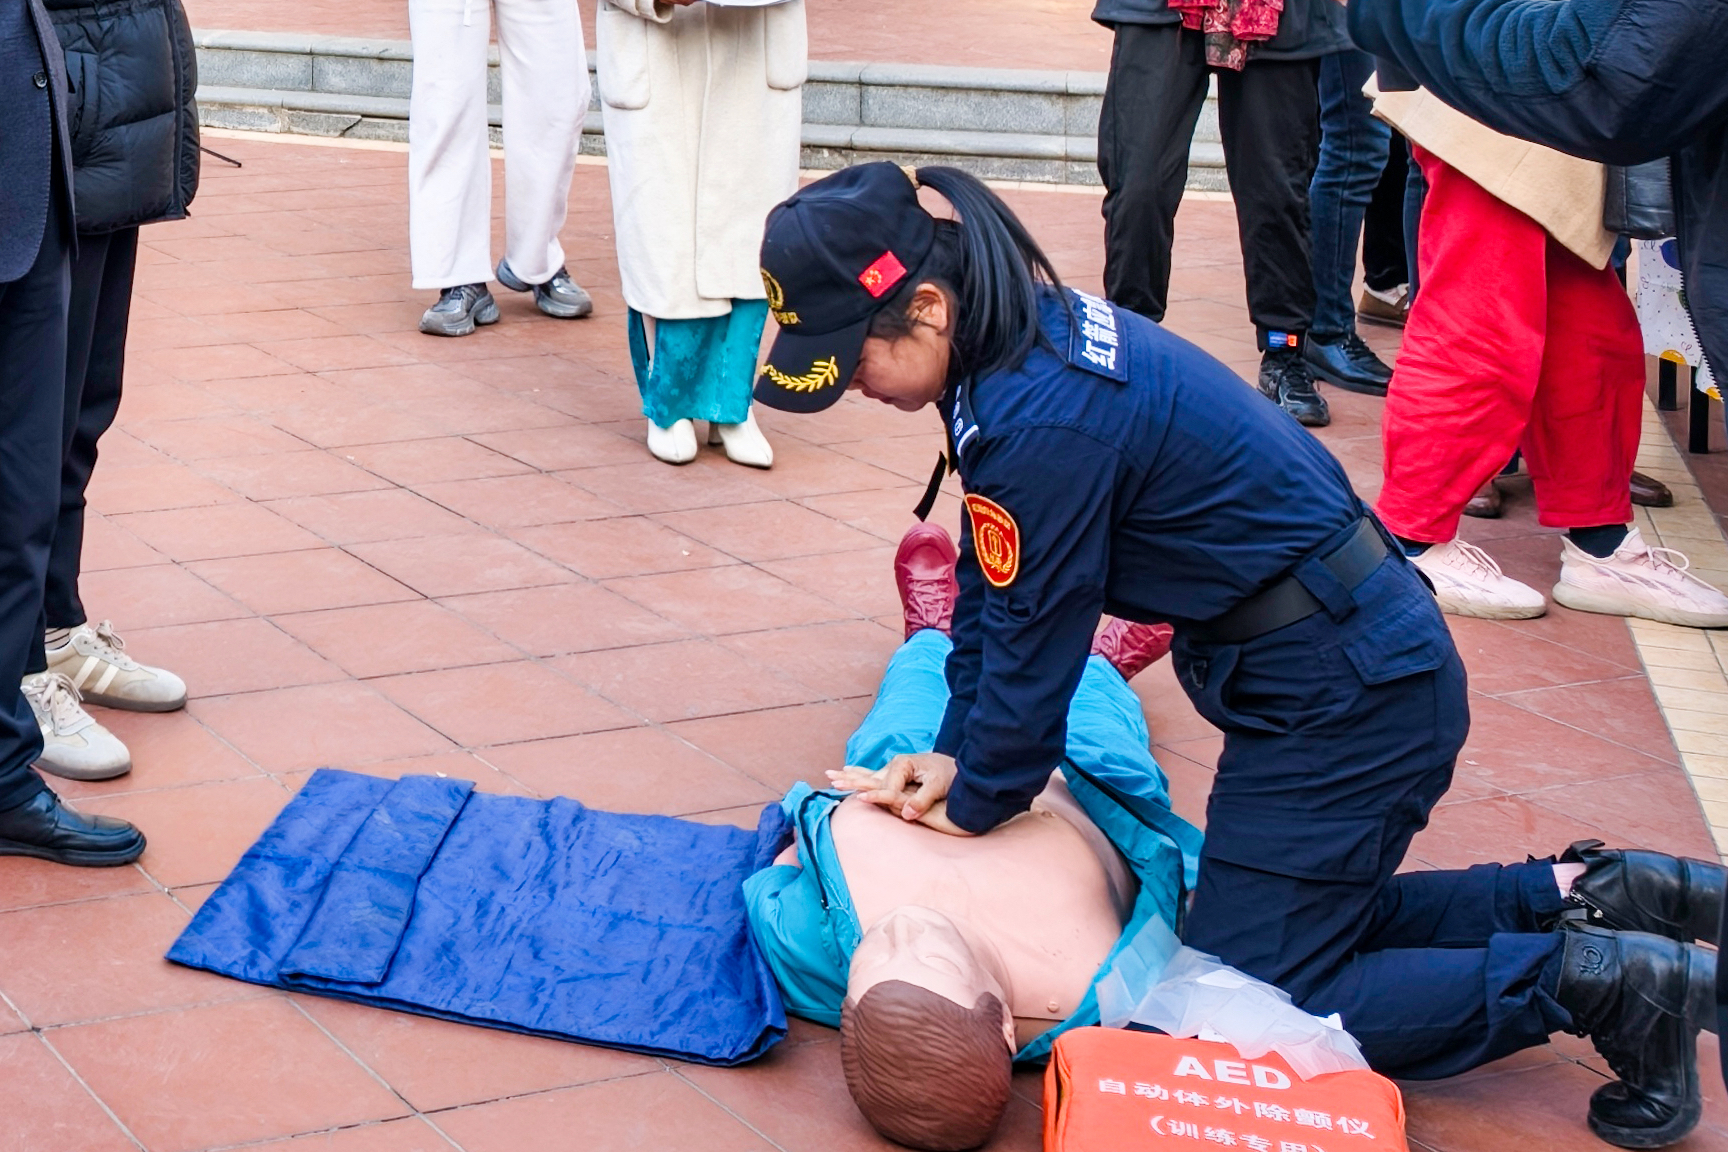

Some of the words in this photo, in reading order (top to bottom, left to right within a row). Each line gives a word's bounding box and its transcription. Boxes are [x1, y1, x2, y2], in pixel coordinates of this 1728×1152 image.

[1173, 1056, 1292, 1090] AED
[1098, 1078, 1376, 1139] 自动体外除颤仪
